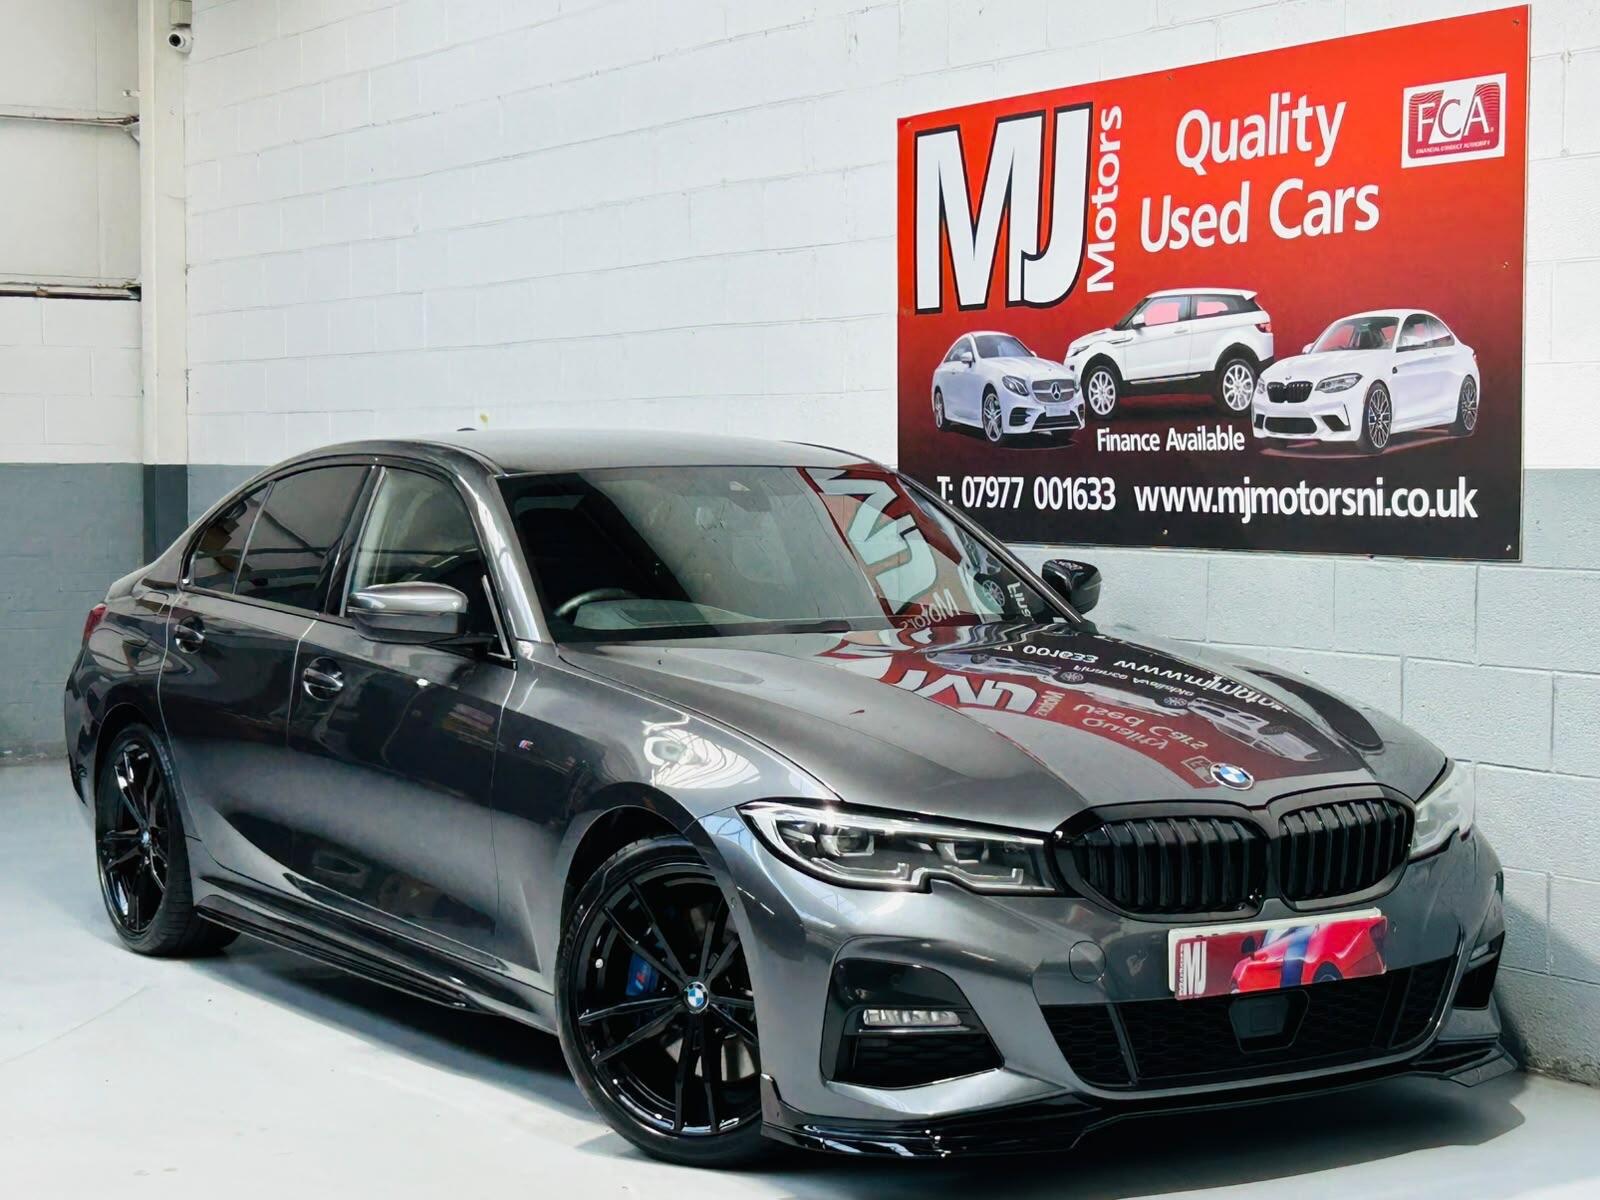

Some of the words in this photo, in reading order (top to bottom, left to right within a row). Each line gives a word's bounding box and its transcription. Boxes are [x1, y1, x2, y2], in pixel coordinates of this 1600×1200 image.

[1175, 91, 1347, 176] Quality
[1417, 95, 1490, 143] FCA
[914, 102, 1093, 314] MJ
[1086, 105, 1123, 293] Motors
[1140, 181, 1251, 253] Used
[1269, 178, 1380, 240] Cars
[1096, 427, 1161, 452] Finance
[1165, 424, 1246, 452] Available
[936, 475, 953, 505] T:
[961, 475, 1025, 509] 07977
[1033, 476, 1117, 511] 001633
[1133, 476, 1479, 524] www.mjmotorsni.co.uk
[1183, 940, 1207, 996] MJ
